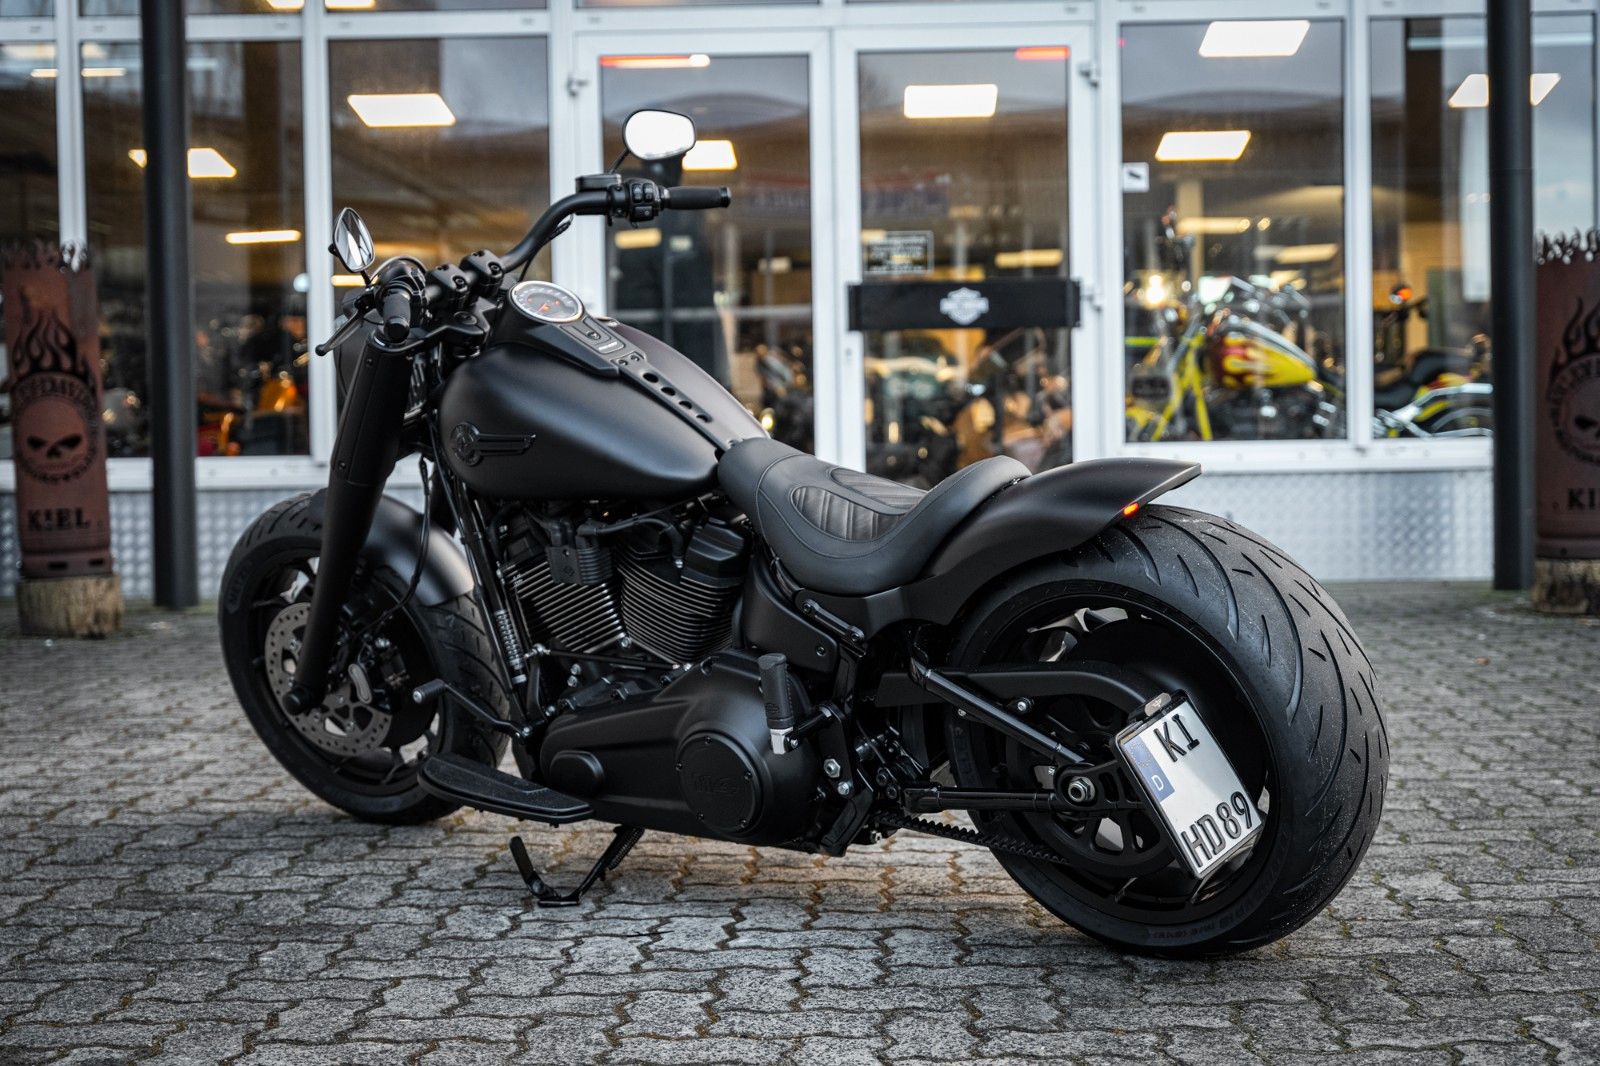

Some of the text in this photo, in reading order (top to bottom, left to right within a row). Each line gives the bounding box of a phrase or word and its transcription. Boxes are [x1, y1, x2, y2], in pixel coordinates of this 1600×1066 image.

[1568, 489, 1600, 510] KI
[28, 508, 90, 532] KIEL
[1154, 714, 1200, 762] KI
[1151, 774, 1163, 791] D
